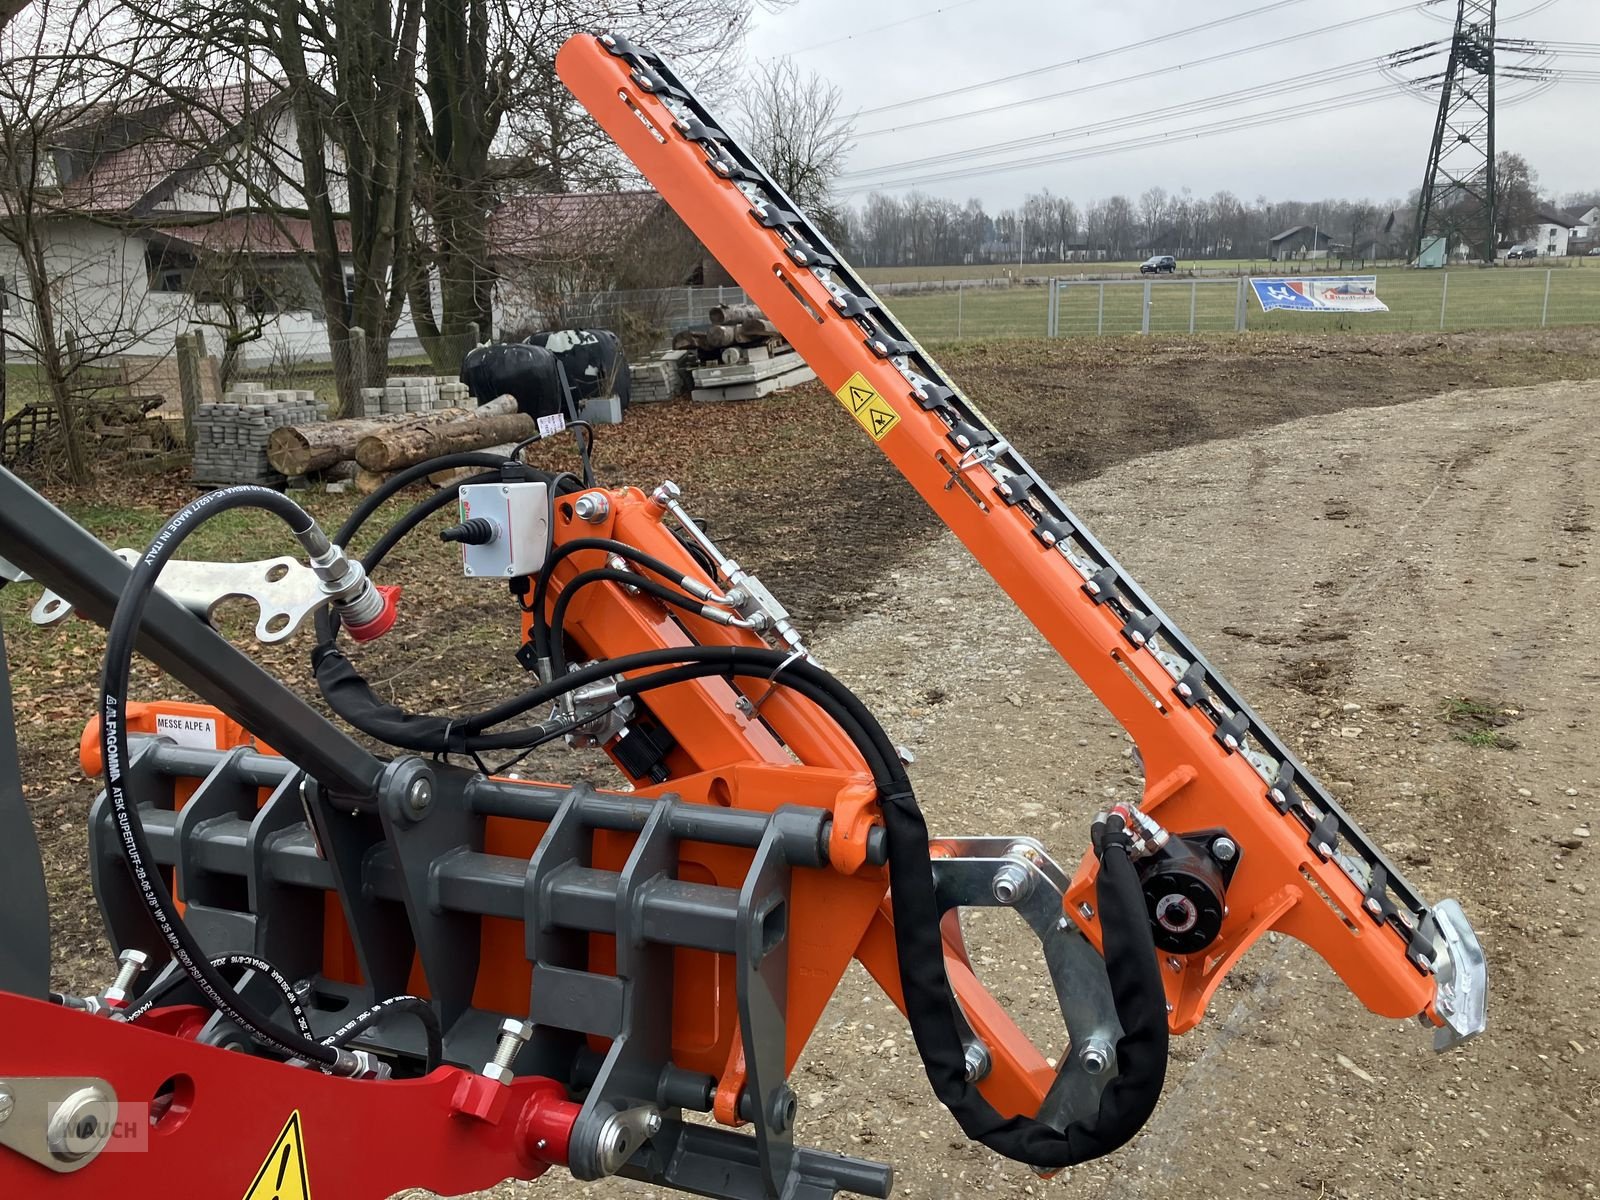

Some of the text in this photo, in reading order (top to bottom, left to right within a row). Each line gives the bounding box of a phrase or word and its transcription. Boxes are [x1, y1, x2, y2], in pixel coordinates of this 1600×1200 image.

[192, 490, 225, 511] IC-152/7
[168, 509, 193, 532] MADE
[159, 531, 172, 543] IN
[144, 541, 165, 566] ITALY
[158, 718, 211, 732] MESSE ALPE A
[106, 706, 121, 782] ALFAGOMMA
[112, 787, 126, 811] AT5K
[117, 812, 151, 891] SUPERTUFF-2B-06
[154, 908, 166, 923] WP
[161, 922, 172, 933] 35
[167, 931, 180, 949] MPa
[252, 958, 270, 972] MSHA
[270, 969, 283, 984] BAR
[198, 979, 228, 1009] FLEXOPAK
[280, 981, 291, 993] 350
[286, 992, 297, 1004] WP
[298, 1016, 309, 1031] 2SC
